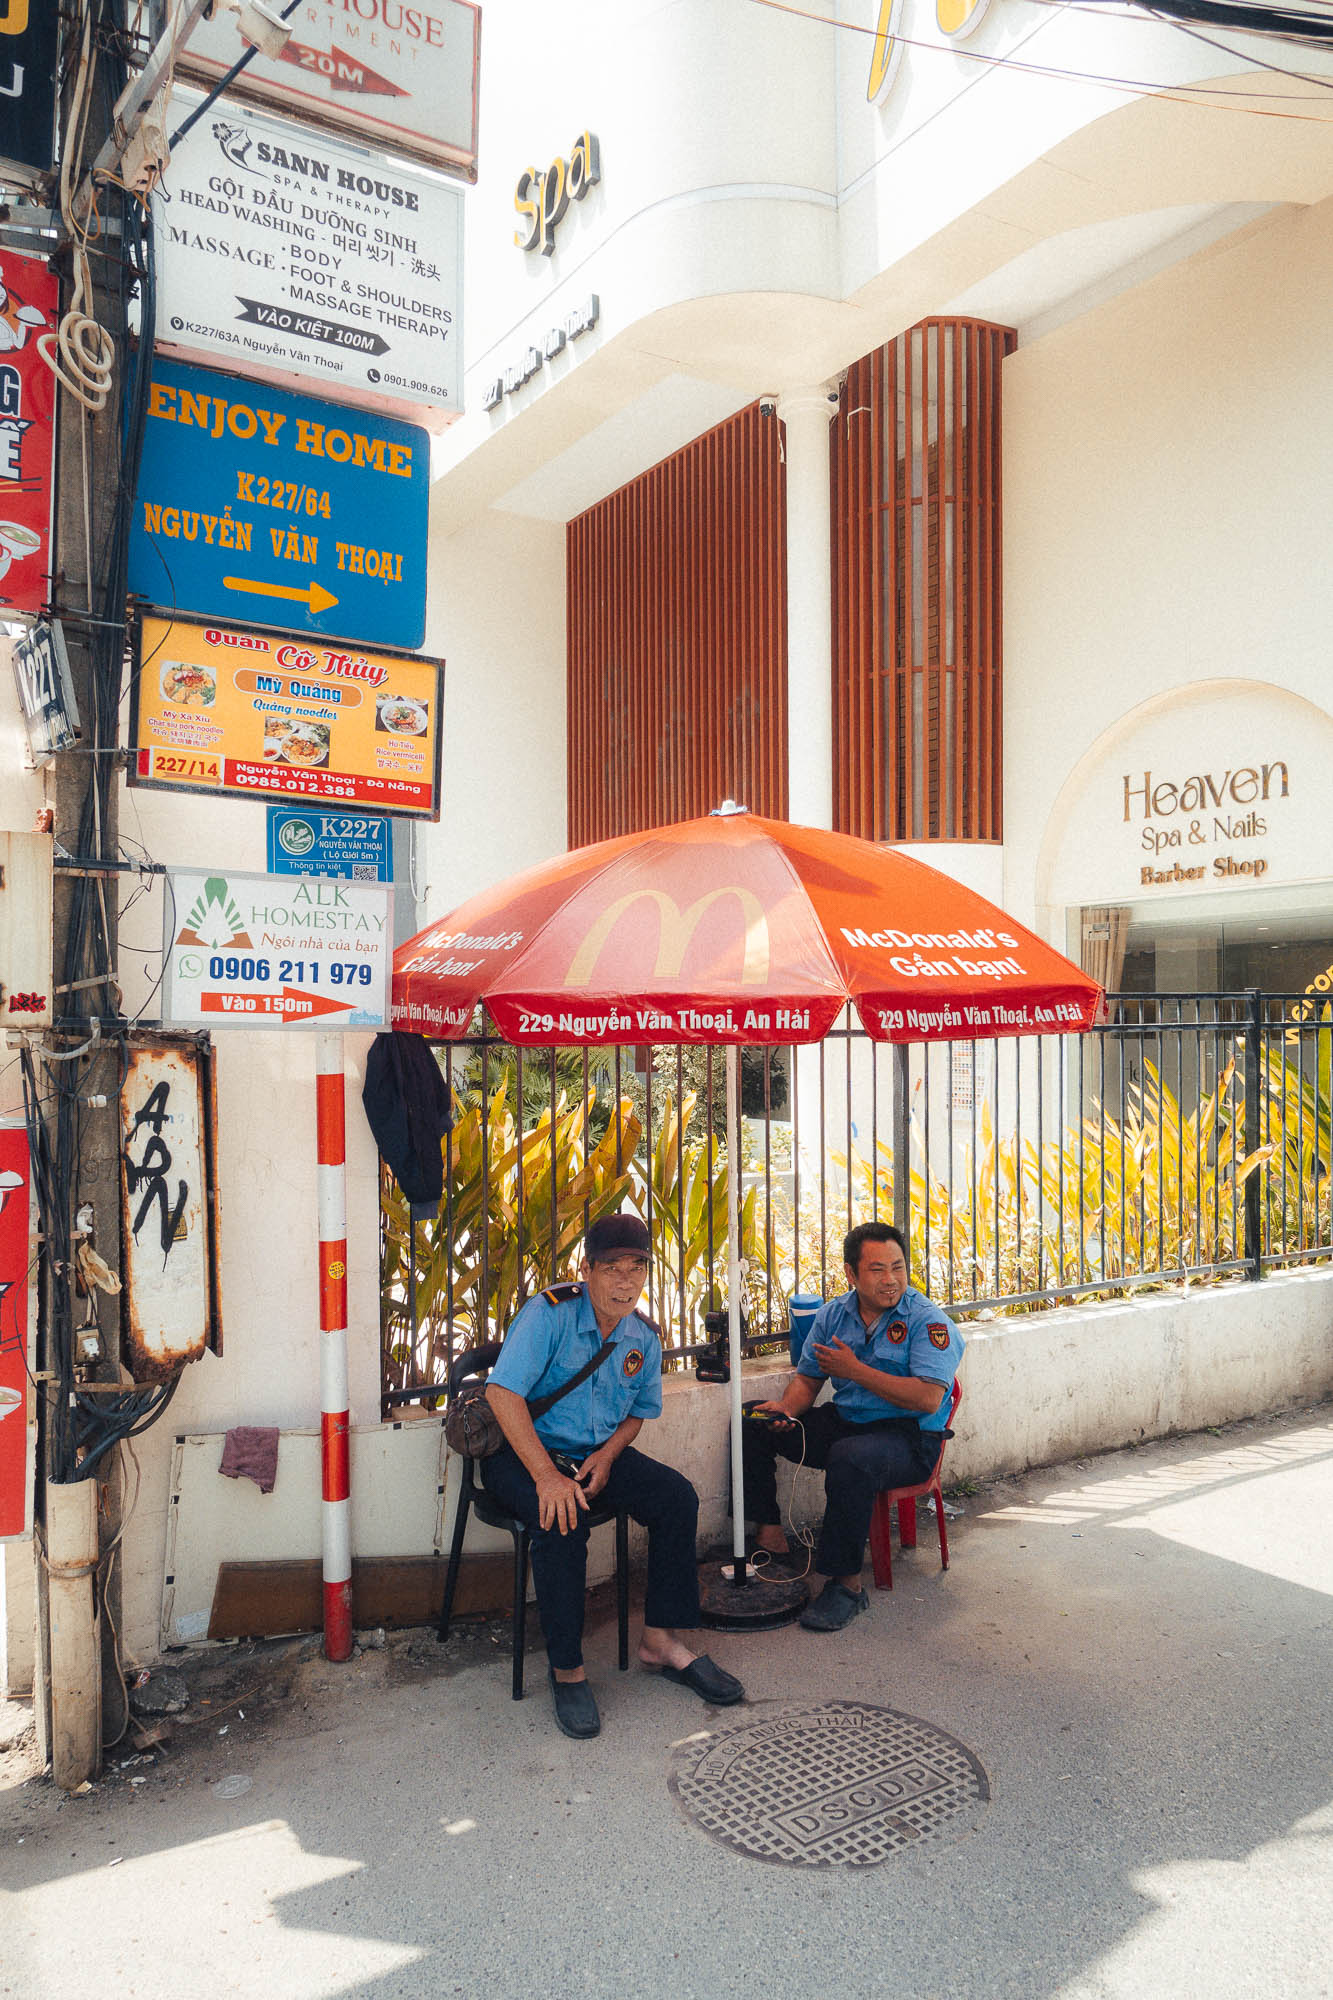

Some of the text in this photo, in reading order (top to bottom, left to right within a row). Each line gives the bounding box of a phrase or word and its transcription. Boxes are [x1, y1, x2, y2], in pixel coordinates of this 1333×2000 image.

[307, 8, 418, 61] RTMENT
[299, 50, 364, 86] 20M
[257, 142, 419, 212] SANN HOUSE
[273, 174, 390, 220] SPA & THERAPY
[180, 189, 229, 215] HEAD
[233, 204, 315, 241] WASHING
[209, 177, 417, 255] GỘI ĐẦU DƯỠNG SINH
[170, 226, 276, 270] MASSAGE
[290, 244, 342, 270] BODY
[332, 234, 362, 257] 머리
[366, 244, 394, 267] 씻기
[411, 257, 441, 281] 洗头
[290, 264, 452, 324] FOOT & SHOULDERS
[290, 284, 448, 342] MASSAGE THERAPY
[257, 307, 375, 351] VÀO KIỆT 100M
[185, 321, 344, 372] K227/63A Nguyễn Văn Thoại
[384, 373, 449, 398] 0901.909.626
[147, 382, 412, 478] ENJOY HOME
[236, 470, 331, 519] K227/64
[143, 502, 404, 586] NGUYỄN VĂN THOẠI
[204, 629, 270, 652] Quán
[275, 645, 389, 688] Cô Thủy
[256, 675, 342, 704] Mỳ Quảng
[295, 707, 338, 721] noodles
[155, 755, 218, 777] 227/14
[236, 763, 288, 778] Nguyễn
[291, 768, 318, 782] Văn
[321, 773, 356, 786] Thoại
[366, 779, 385, 788] Đà
[388, 781, 422, 794] Nẵng
[236, 774, 356, 797] 0985.012.388
[1123, 760, 1290, 823] Heaven
[320, 817, 382, 840] K227
[1141, 811, 1268, 856] Spa & Nails
[319, 838, 383, 852] NGUYỄN VĂN THOẠI
[361, 852, 374, 860] 5m
[289, 861, 342, 872] Thông tin kiệt
[1140, 856, 1268, 886] Barber Shop
[293, 883, 350, 908] ALK
[252, 905, 388, 932] HOMESTAY
[261, 932, 379, 955] Ngôi nhà của bạn
[839, 927, 1019, 949] McDonald's
[209, 956, 372, 986] 0906 211 979
[952, 956, 1028, 982] bạn!
[221, 996, 313, 1013] Vào 150m
[878, 1003, 1084, 1033] 229 Nguyễn Văn Thoại, An Hải
[518, 1007, 811, 1038] 229 Nguyễn Văn Thoại, An Hải
